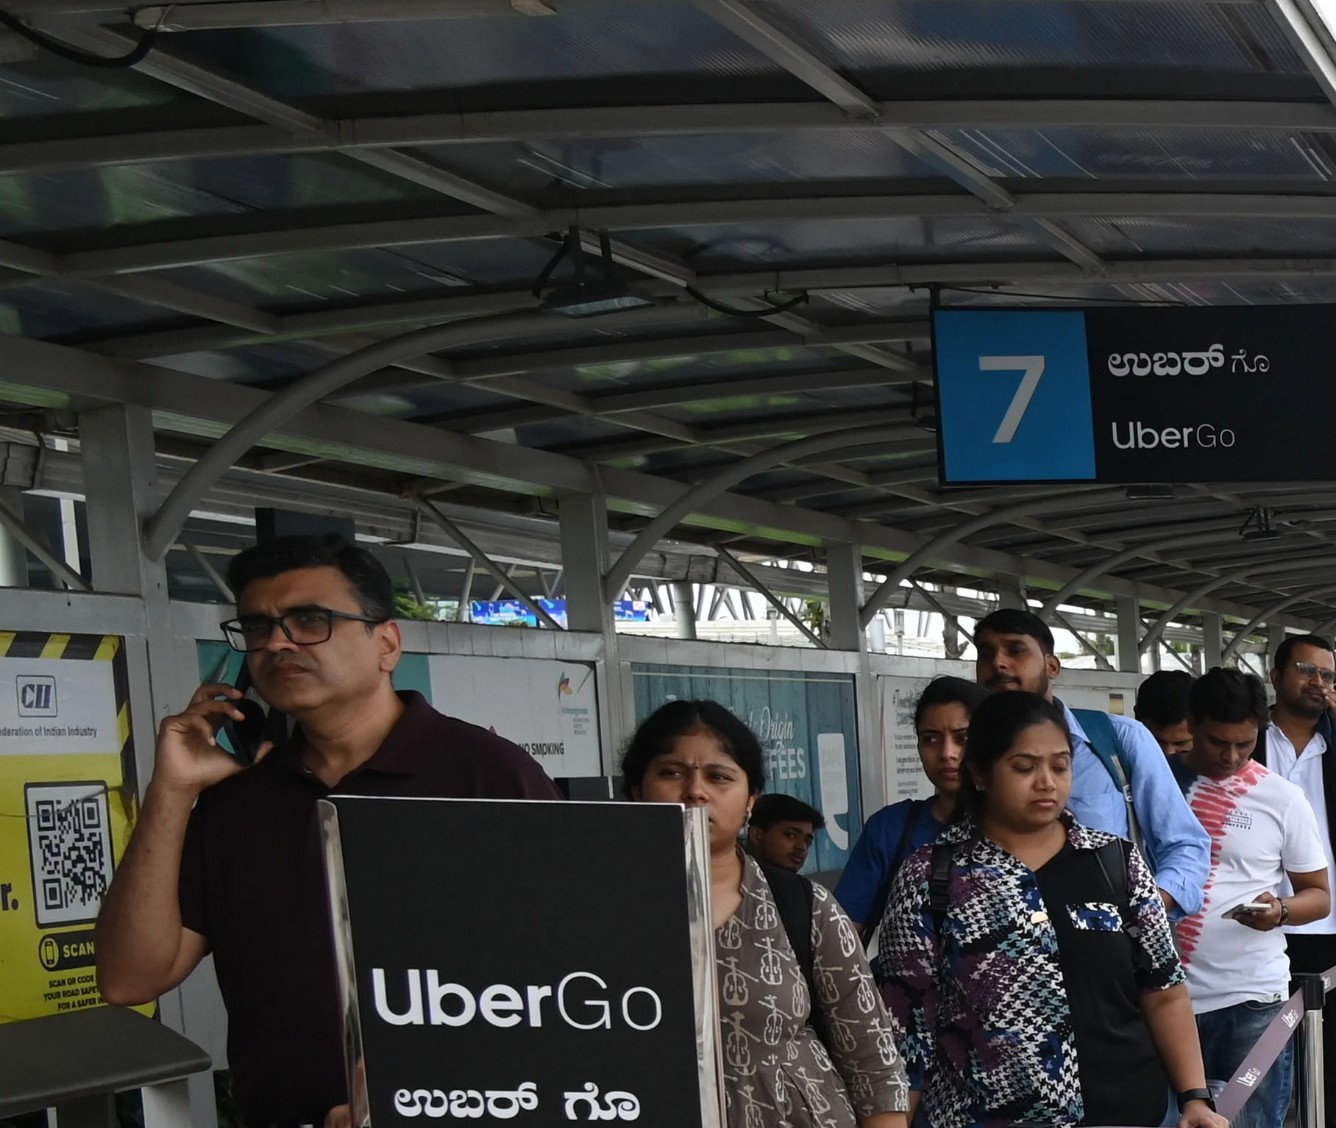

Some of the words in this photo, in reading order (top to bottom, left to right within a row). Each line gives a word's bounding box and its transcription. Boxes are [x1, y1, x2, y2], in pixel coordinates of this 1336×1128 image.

[1108, 343, 1225, 377] ಉಬರ್
[978, 355, 1045, 443] 7
[1111, 421, 1236, 450] UberGo
[21, 684, 52, 709] CII
[34, 725, 43, 737] of
[43, 725, 67, 737] Indian
[68, 725, 98, 738] Industry
[531, 742, 565, 756] SMOKING
[764, 747, 806, 780] FEES
[63, 942, 95, 958] SCAN
[77, 975, 94, 984] CODE
[371, 968, 662, 1031] UberGo
[394, 1082, 539, 1119] ಉಬರ್
